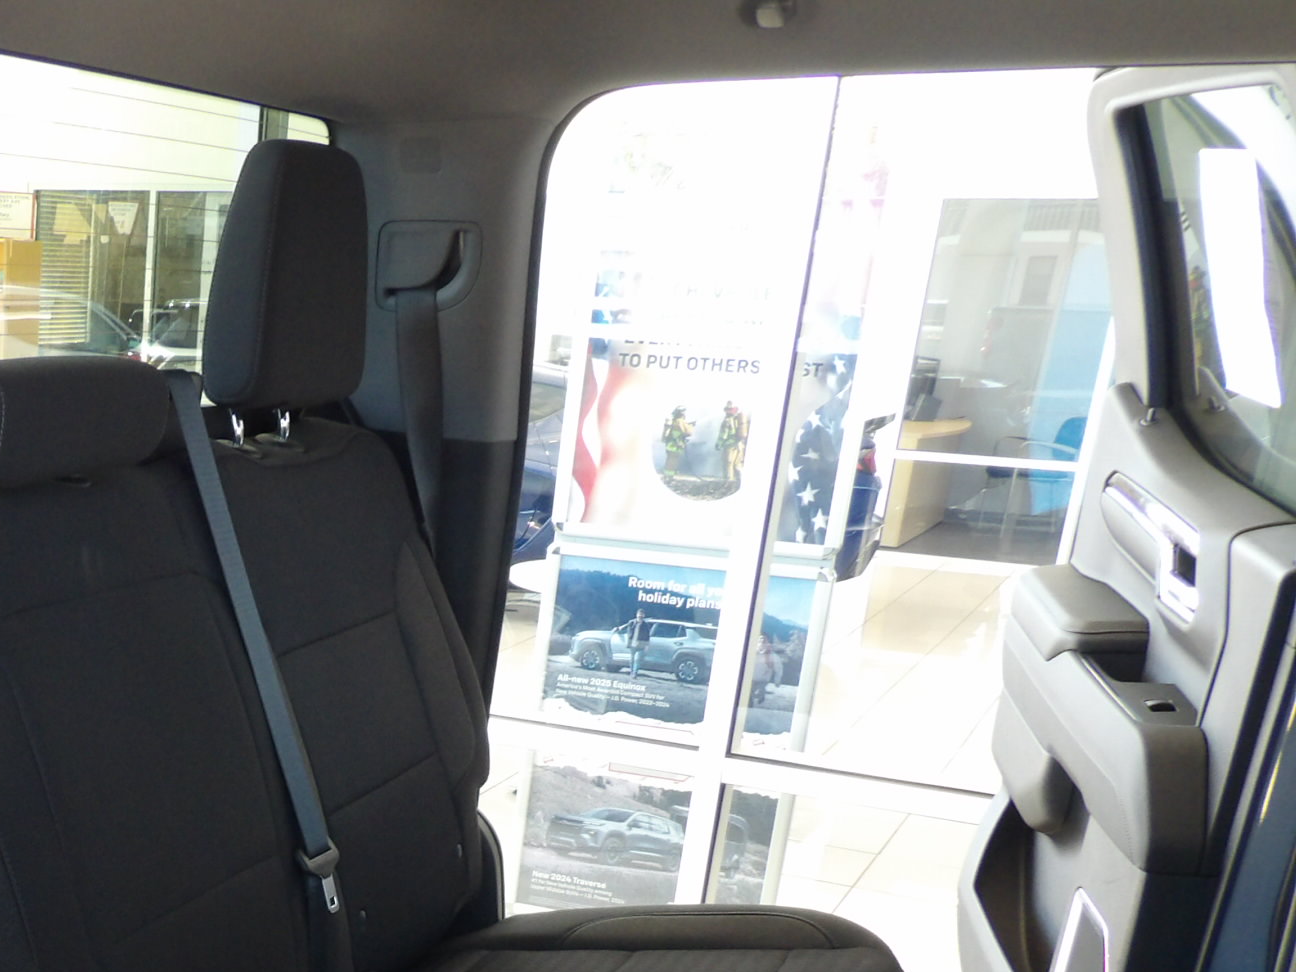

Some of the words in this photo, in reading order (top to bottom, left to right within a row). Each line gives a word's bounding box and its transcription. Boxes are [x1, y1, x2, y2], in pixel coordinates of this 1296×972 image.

[618, 352, 641, 369] TO
[646, 354, 683, 370] PUT
[687, 356, 761, 374] OTHERS
[802, 361, 824, 377] ST
[628, 576, 665, 590] Room
[667, 579, 688, 593] for
[638, 590, 685, 608] holiday
[556, 674, 589, 685] All-new
[590, 676, 611, 687] 2025
[613, 680, 647, 692] Equinox
[550, 873, 572, 883] 2024
[572, 876, 607, 889] Traverse
